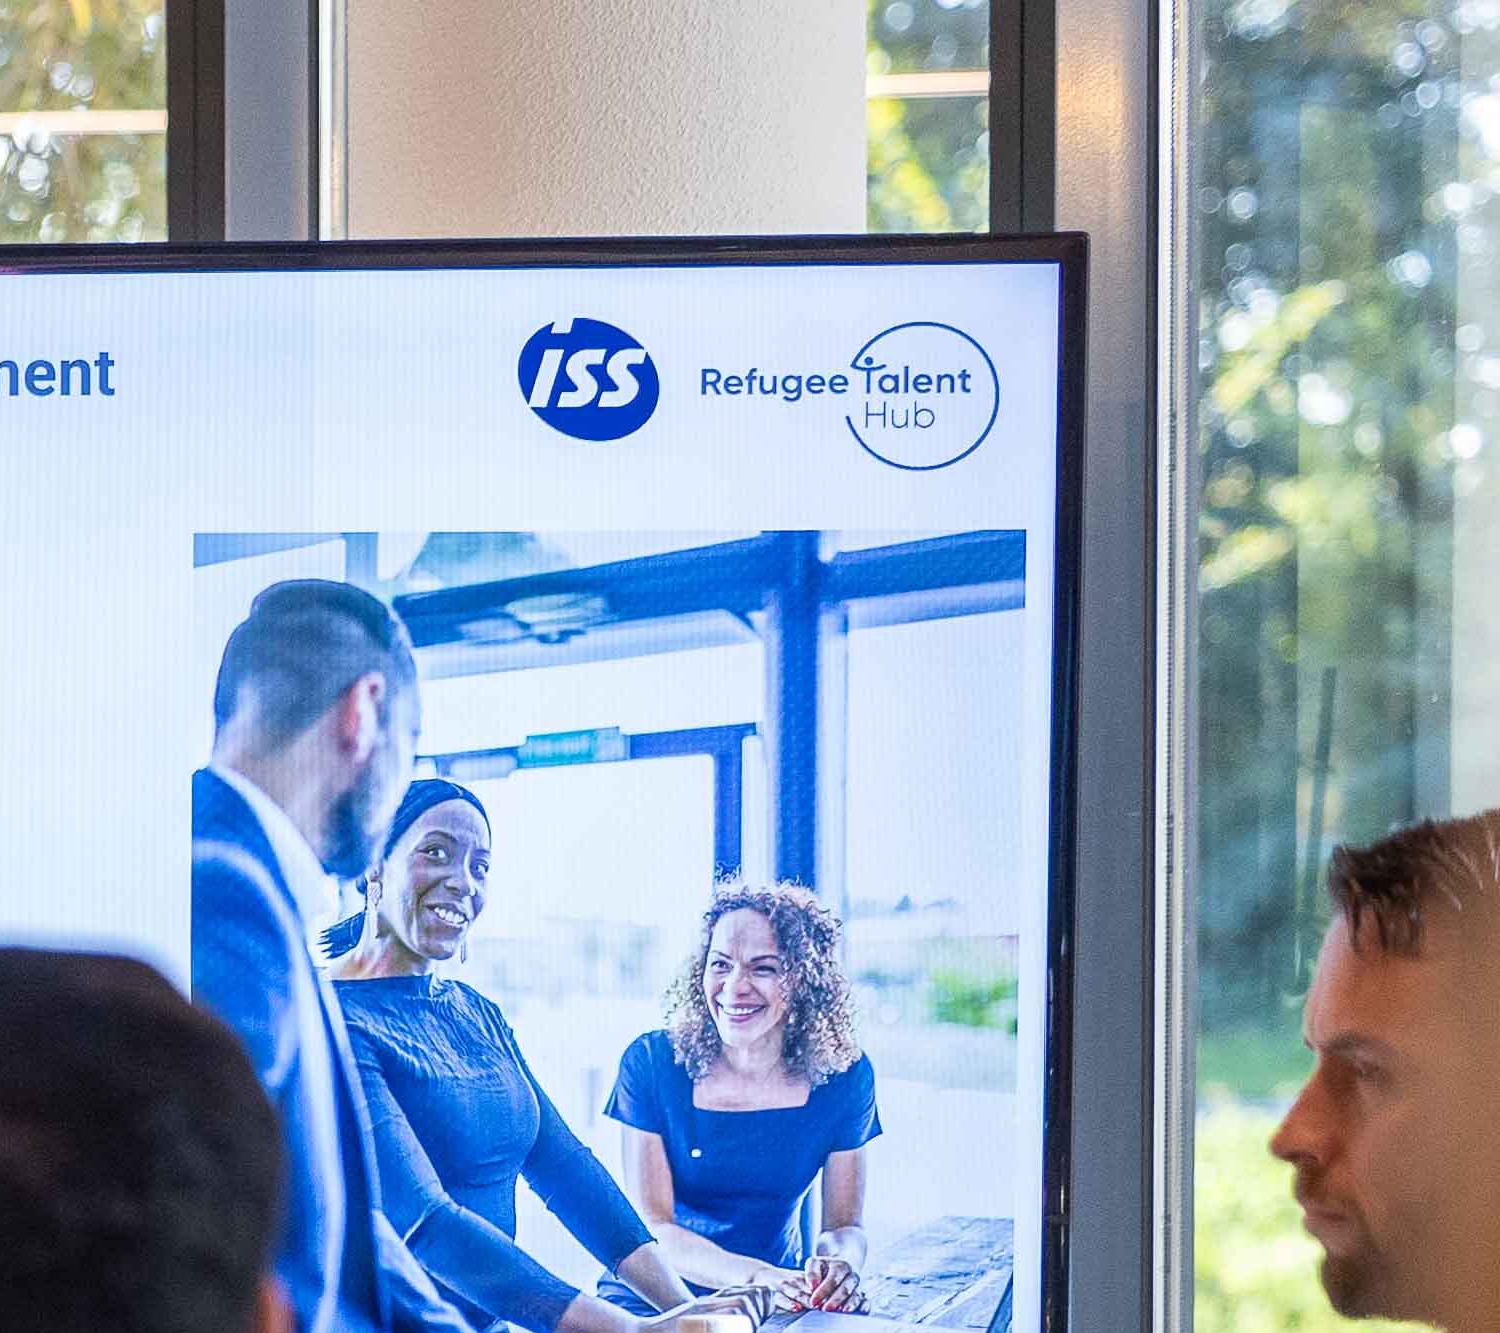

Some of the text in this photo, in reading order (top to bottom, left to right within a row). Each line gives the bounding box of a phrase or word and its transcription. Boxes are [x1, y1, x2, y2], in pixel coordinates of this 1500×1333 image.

[700, 360, 972, 400] Refugee Talent
[864, 401, 936, 429] Hub
